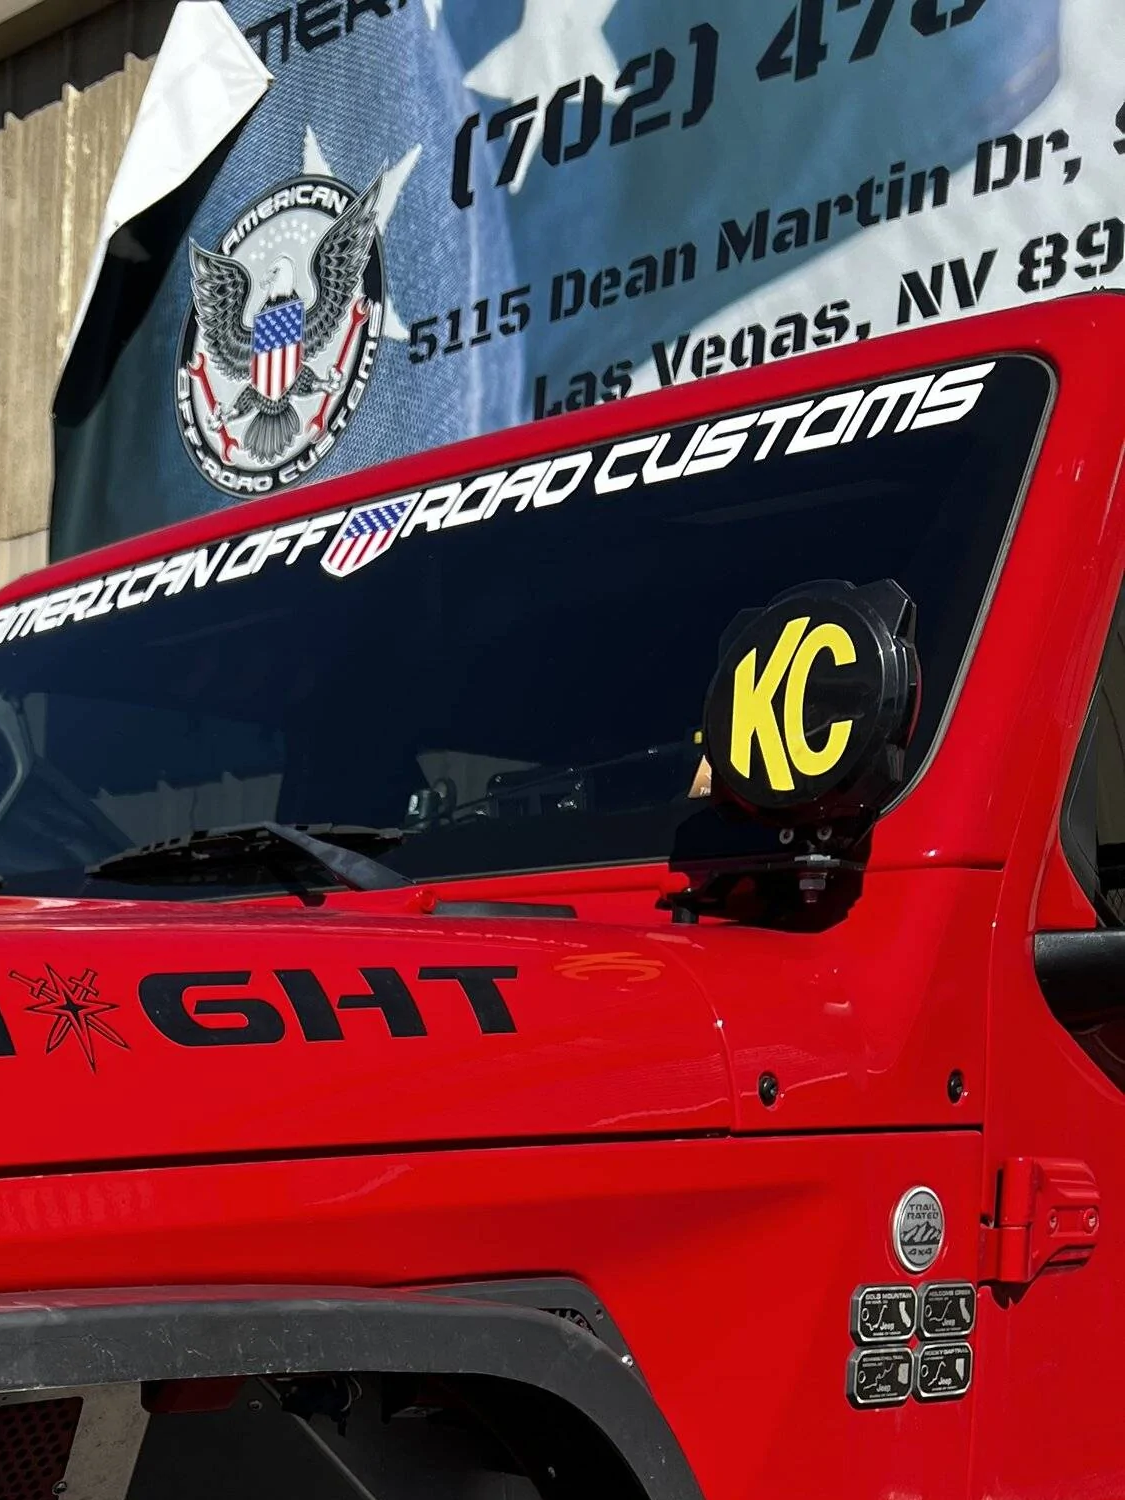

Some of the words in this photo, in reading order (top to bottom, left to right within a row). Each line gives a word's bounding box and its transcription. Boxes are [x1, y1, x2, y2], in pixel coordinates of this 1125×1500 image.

[452, 22, 719, 210] (702)
[222, 184, 349, 254] AMERICAN
[408, 284, 531, 364] 5115
[549, 241, 697, 322] Dean
[716, 161, 950, 272] Martin
[973, 129, 1081, 196] Dr,
[897, 249, 997, 325] NV
[215, 510, 347, 583] OFF
[400, 450, 593, 538] ROAD
[593, 361, 996, 495] CUSTOMS
[730, 616, 857, 791] KC
[907, 1212, 939, 1220] RATED
[909, 1203, 937, 1211] TRAIL
